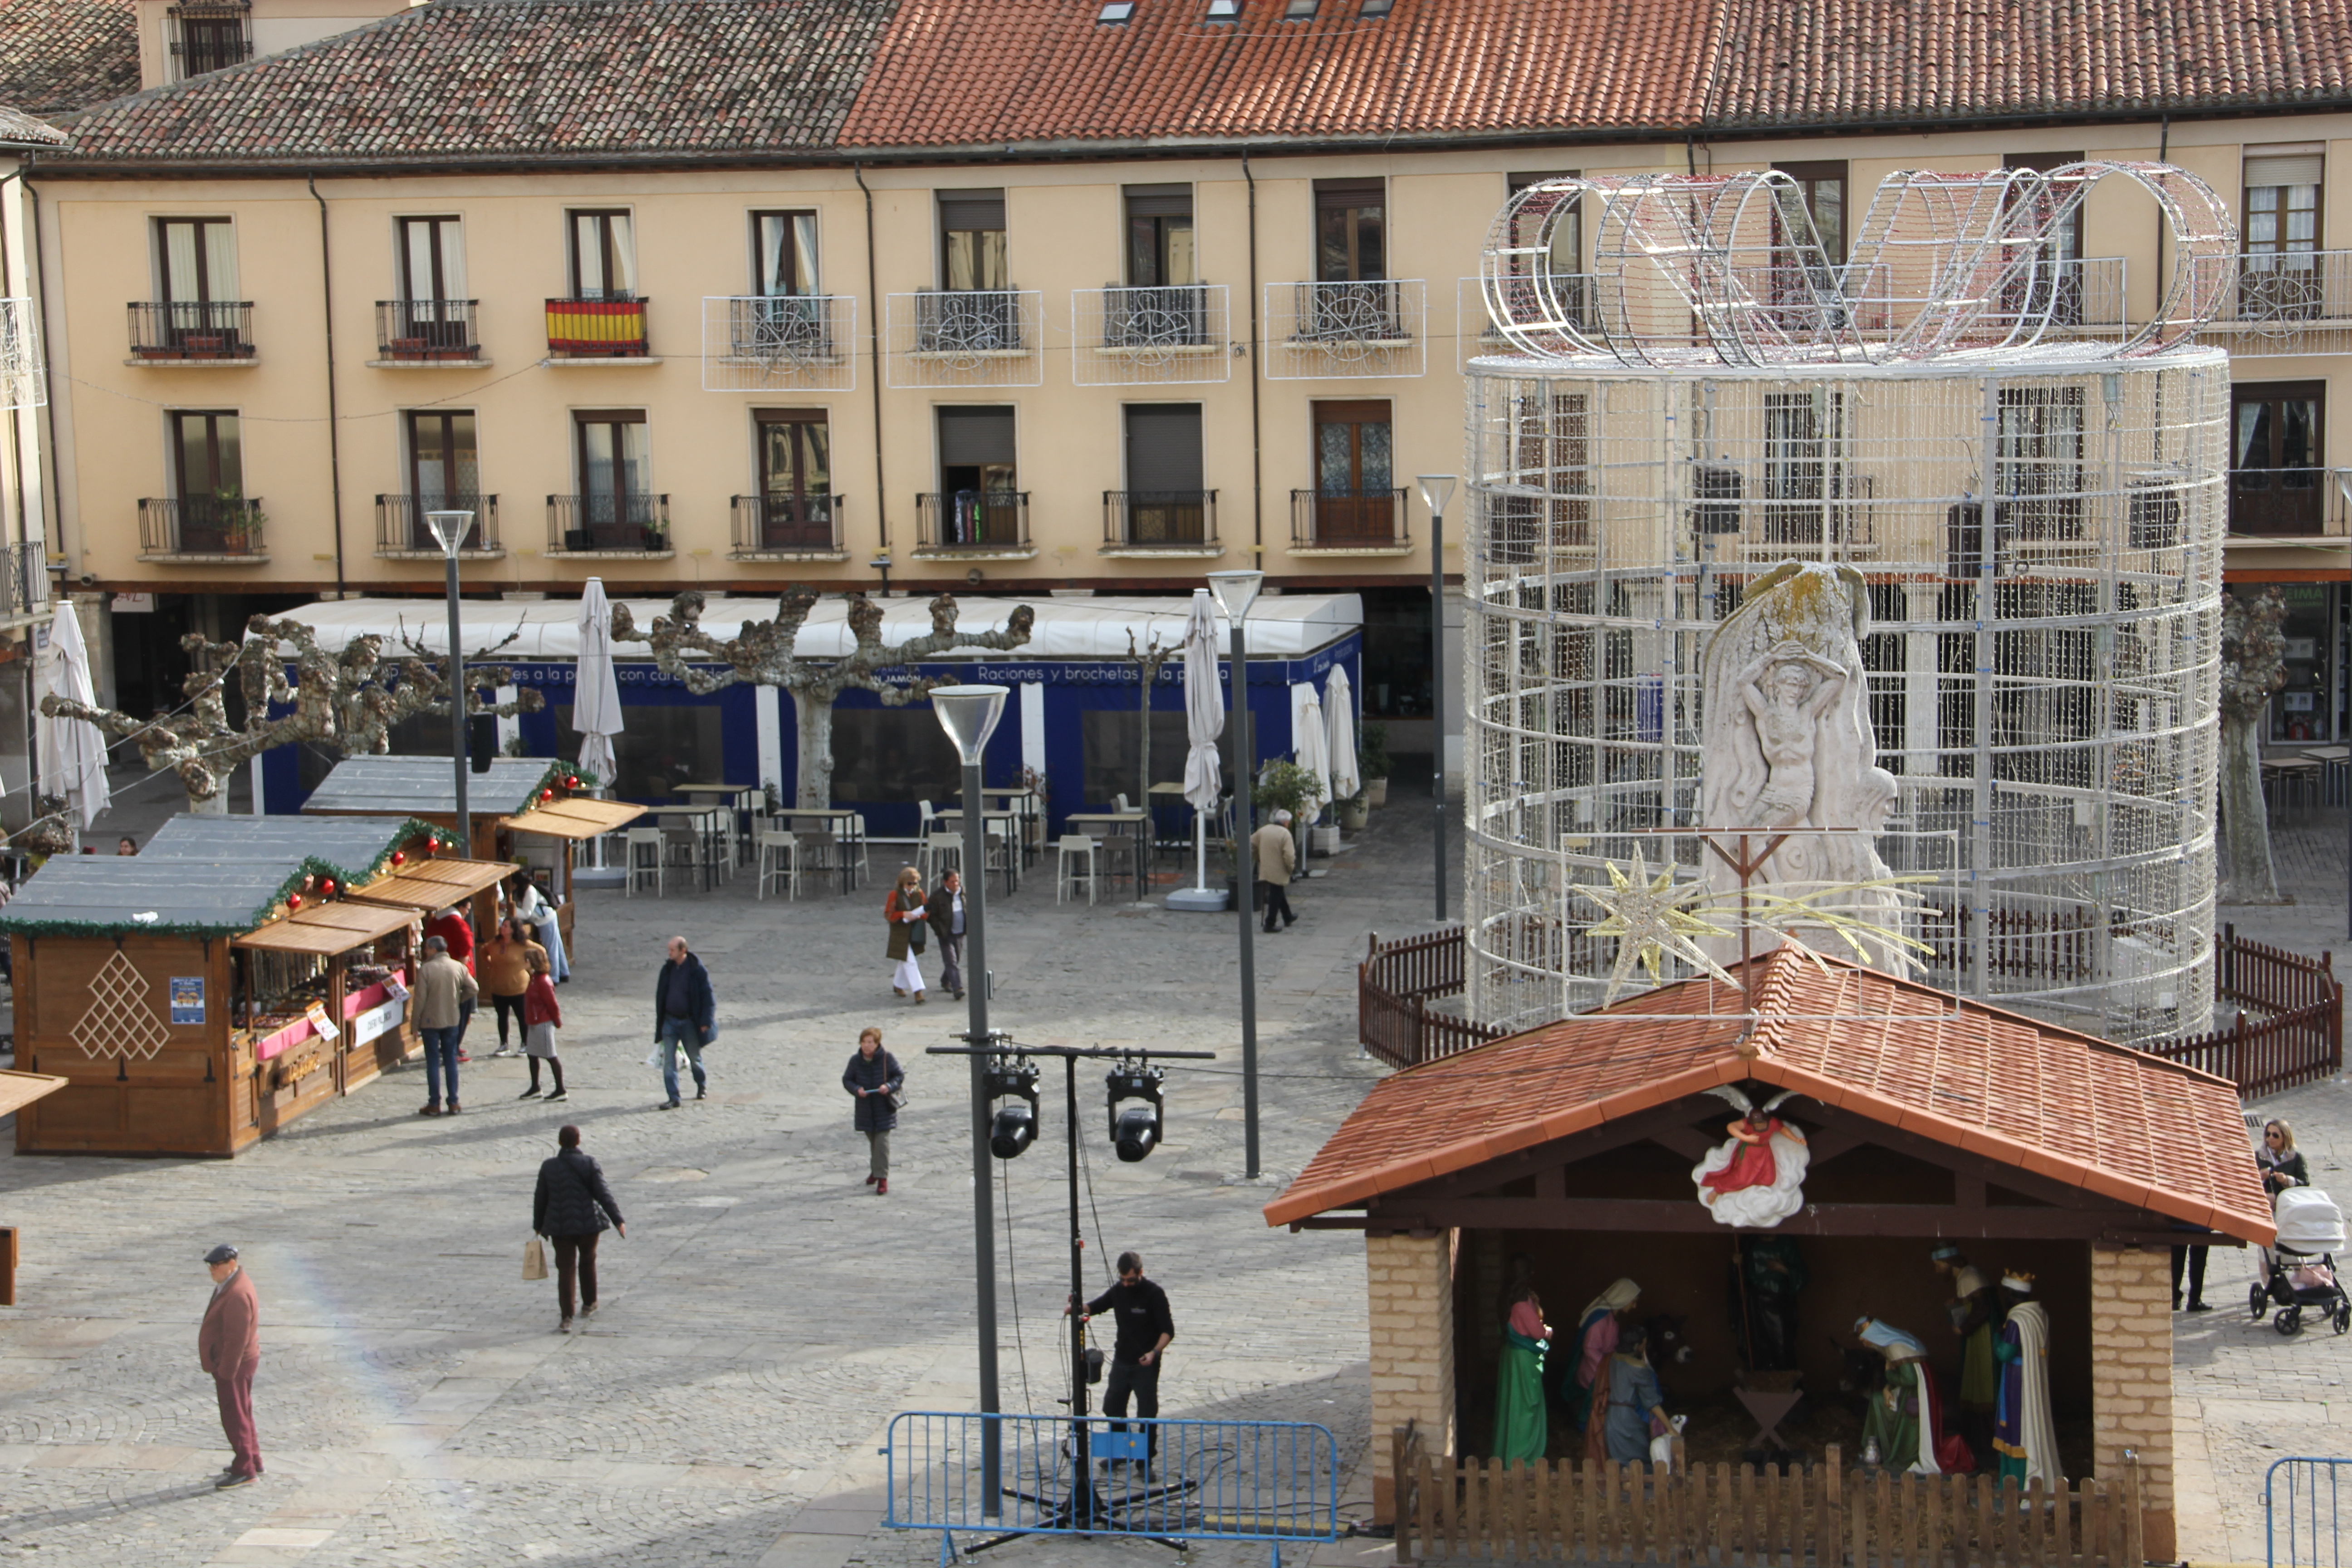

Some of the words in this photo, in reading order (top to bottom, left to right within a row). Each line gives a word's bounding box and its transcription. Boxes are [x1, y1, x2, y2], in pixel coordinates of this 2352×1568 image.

[548, 666, 560, 680] la
[618, 671, 645, 681] con
[978, 666, 1043, 680] Raciones
[1050, 669, 1060, 681] y
[1065, 666, 1139, 680] brochetas
[1159, 666, 1172, 680] la
